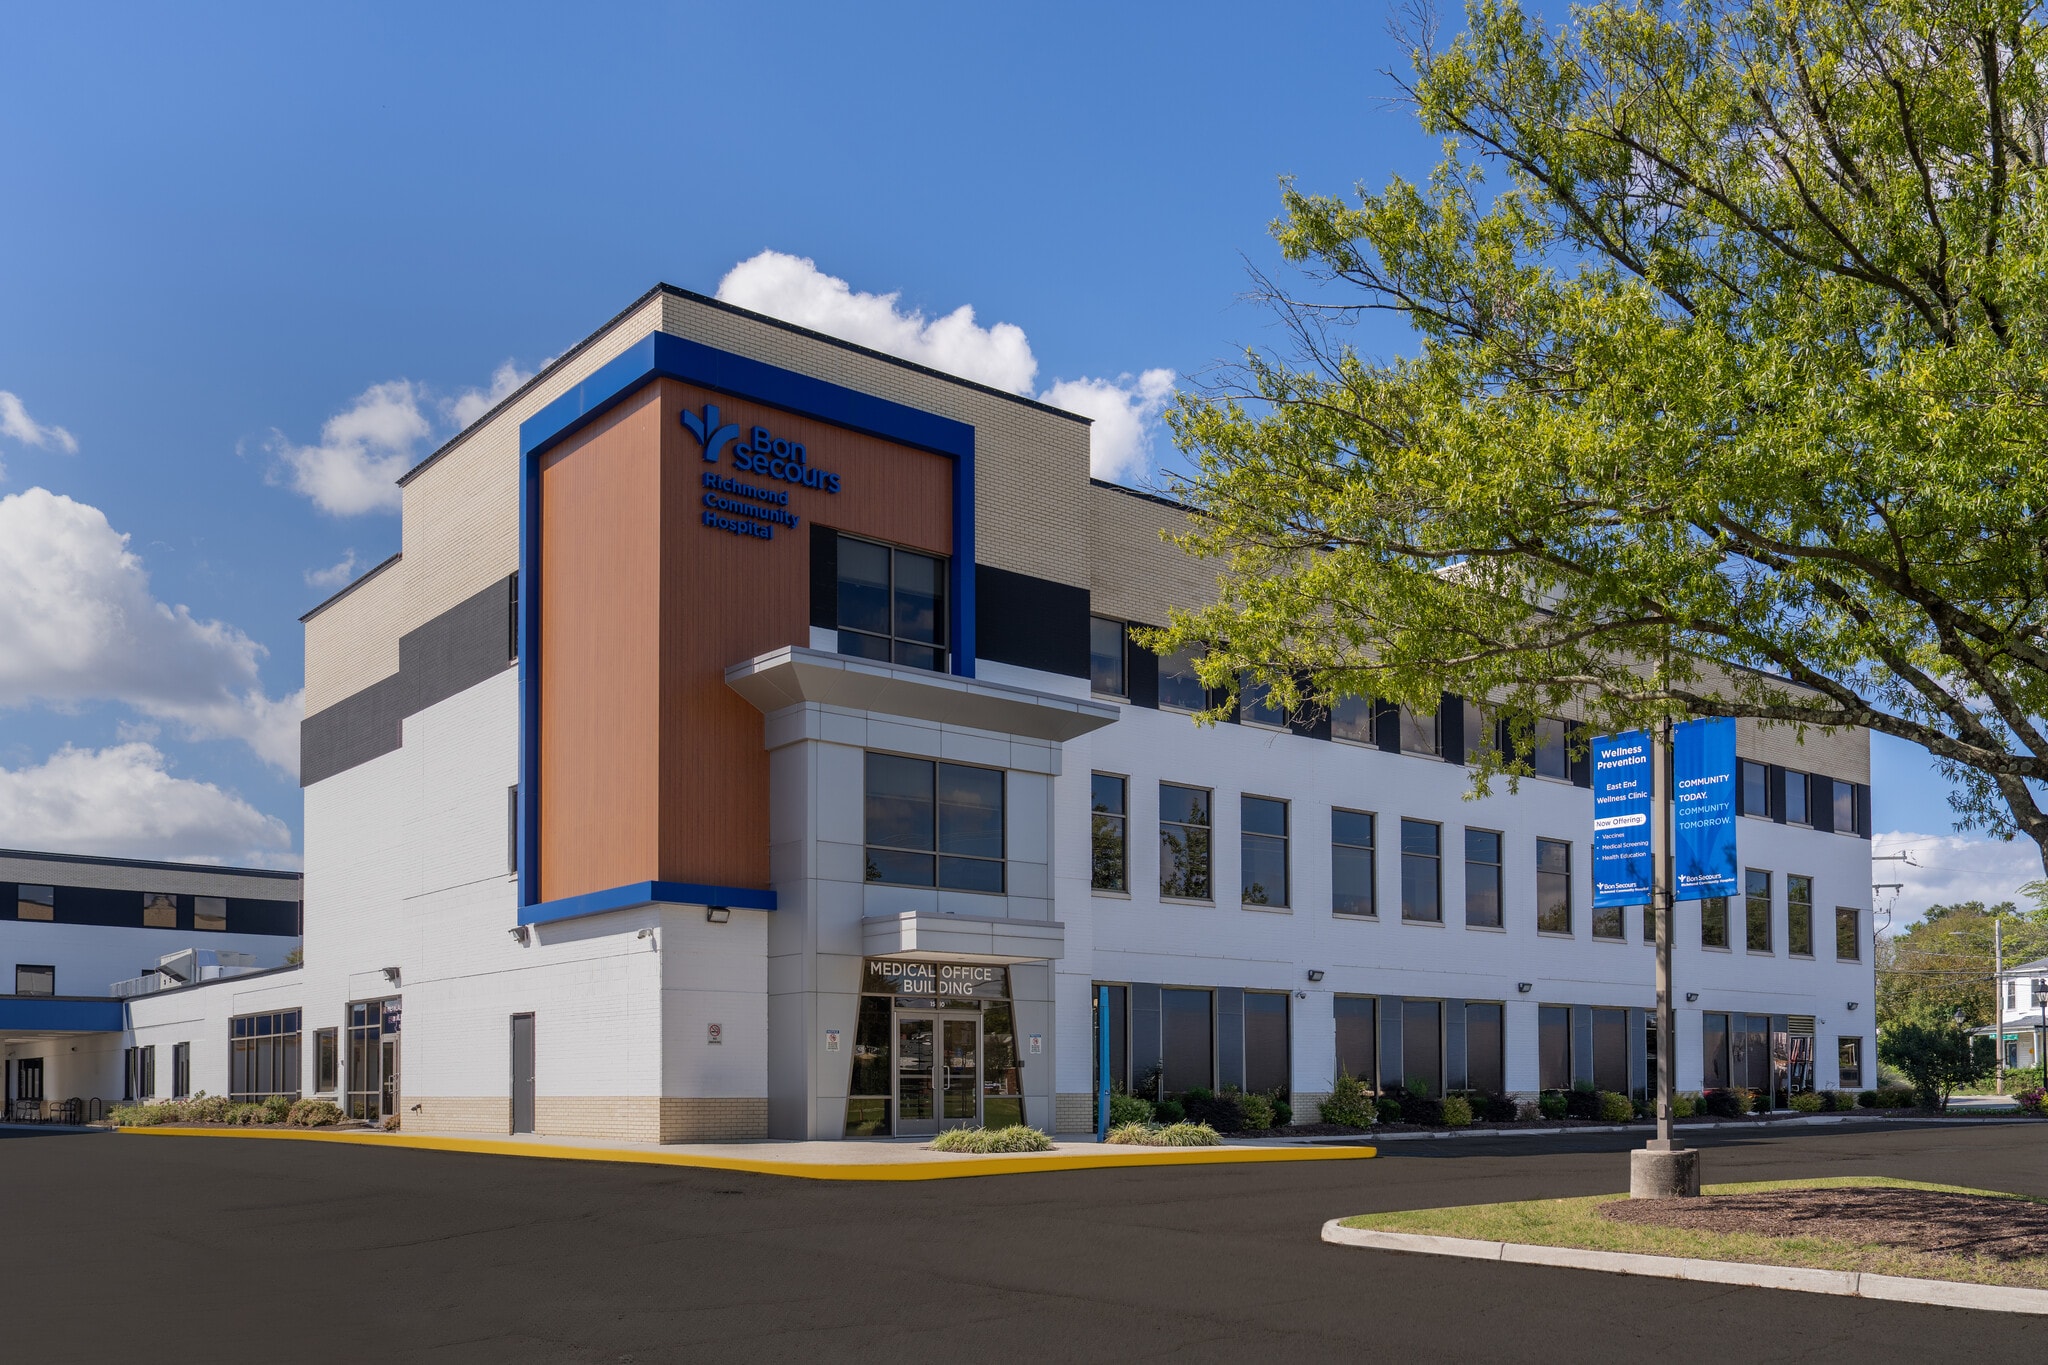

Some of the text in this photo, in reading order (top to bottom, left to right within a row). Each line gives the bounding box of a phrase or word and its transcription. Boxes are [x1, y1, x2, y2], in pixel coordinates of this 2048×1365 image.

[750, 425, 807, 465] Bon
[732, 442, 841, 494] Secours
[702, 471, 789, 506] Richmond
[702, 492, 799, 529] Community
[702, 511, 774, 540] Hospital
[1601, 746, 1642, 759] Wellness
[1597, 756, 1647, 770] Prevention
[1606, 780, 1637, 791] East End
[1679, 774, 1730, 788] COMMUNITY
[1597, 791, 1648, 804] Wellness Clinic
[1679, 791, 1708, 802] TODAY.
[1679, 802, 1730, 816] COMMUNITY
[1596, 815, 1643, 827] Now Offering:
[1680, 816, 1731, 830] TOMORROW.
[1623, 841, 1649, 849] Screening
[1698, 873, 1722, 881] Secours
[870, 961, 992, 981] MEDICAL OFFICE
[903, 979, 973, 995] BUILDING
